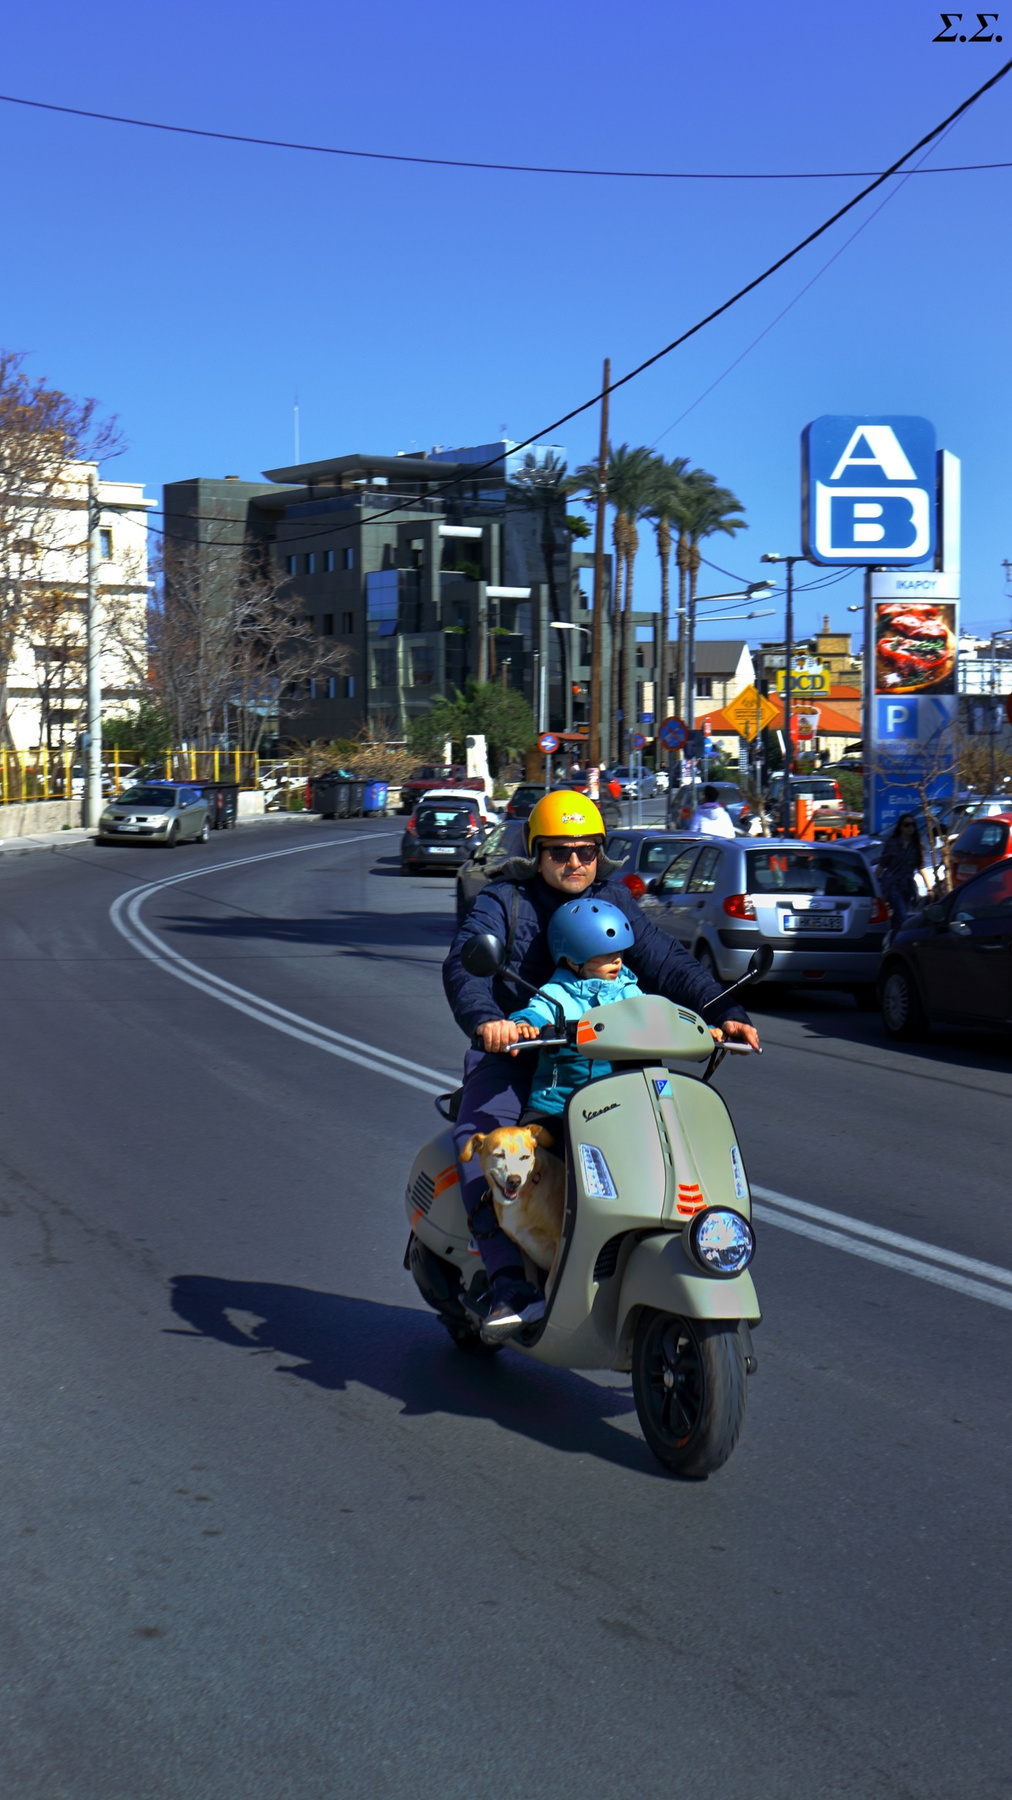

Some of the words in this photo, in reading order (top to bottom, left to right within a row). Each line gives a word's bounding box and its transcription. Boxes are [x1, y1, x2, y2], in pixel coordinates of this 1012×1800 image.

[887, 705, 909, 732] P
[888, 794, 920, 804] Επιλο
[769, 855, 788, 872] N
[582, 1102, 621, 1123] Vespa
